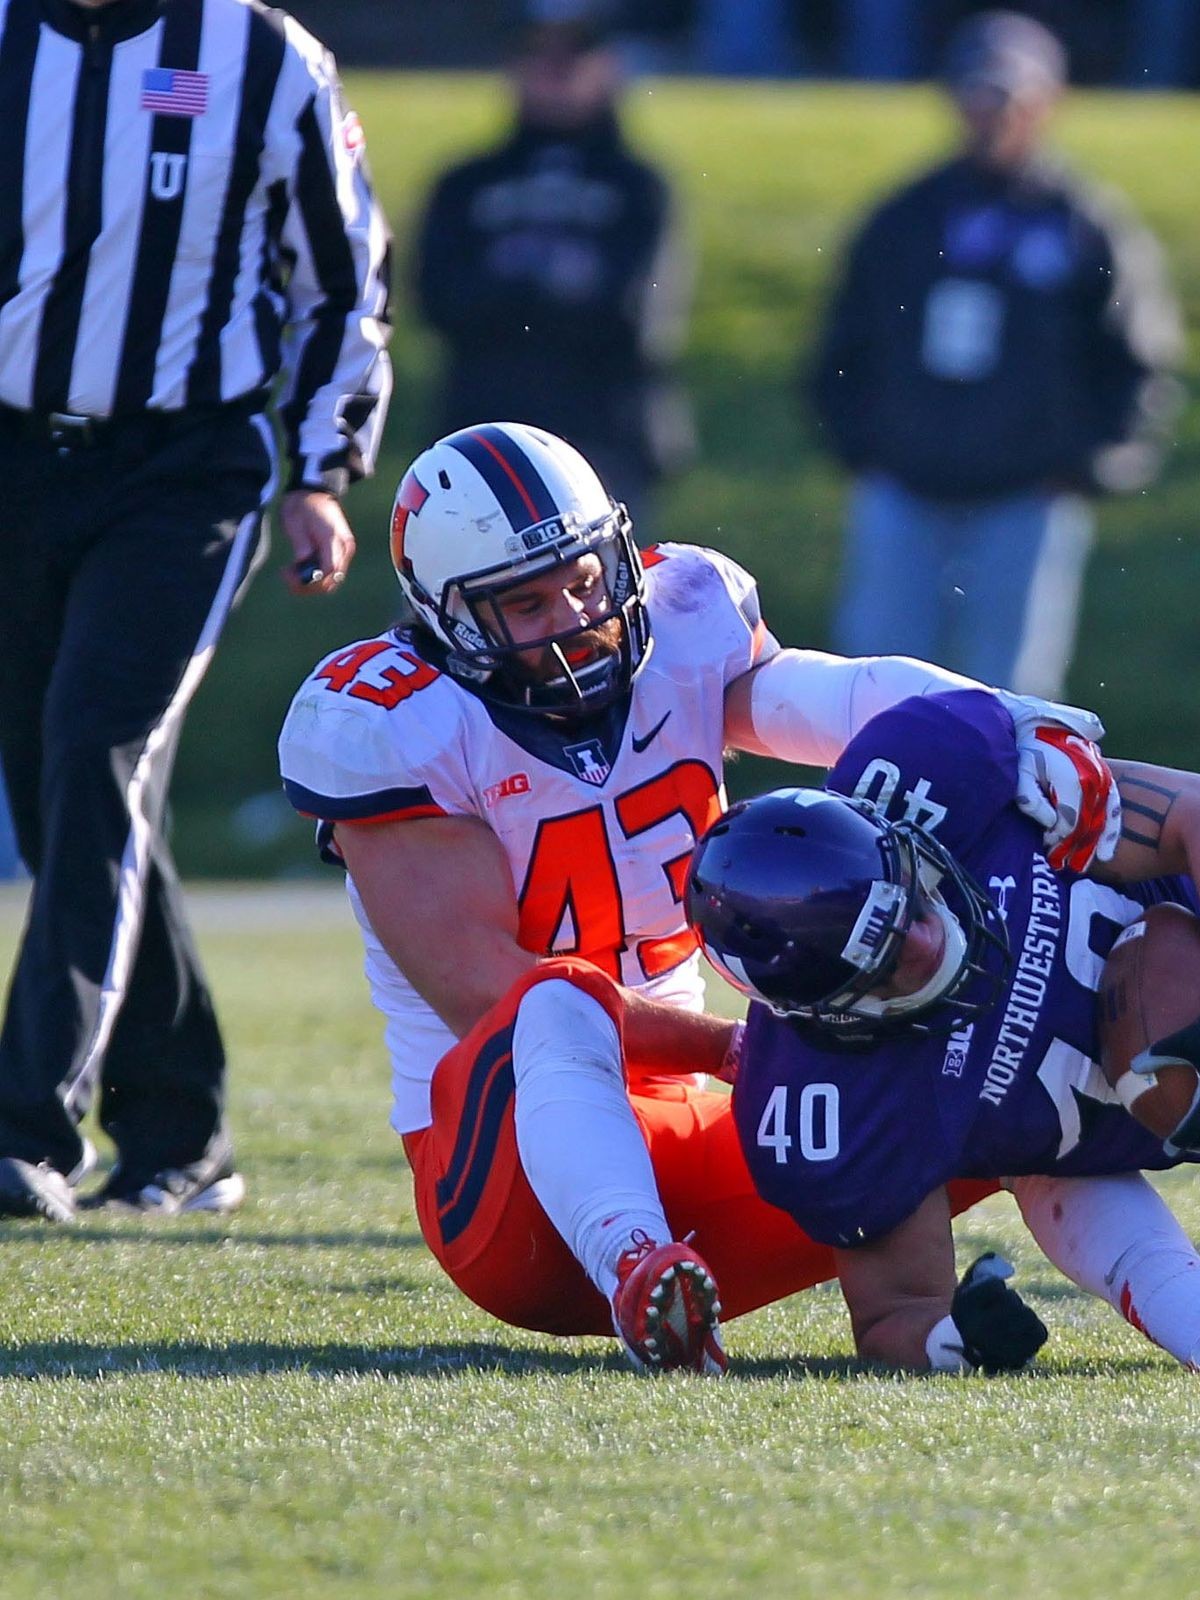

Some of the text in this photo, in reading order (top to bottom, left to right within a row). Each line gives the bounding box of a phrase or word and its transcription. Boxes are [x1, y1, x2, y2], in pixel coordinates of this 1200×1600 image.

[151, 152, 187, 200] U
[313, 640, 442, 712] 43
[851, 757, 949, 834] 40
[515, 758, 723, 988] 43
[979, 852, 1061, 1106] NORTHWESTERN
[756, 1083, 840, 1164] 40
